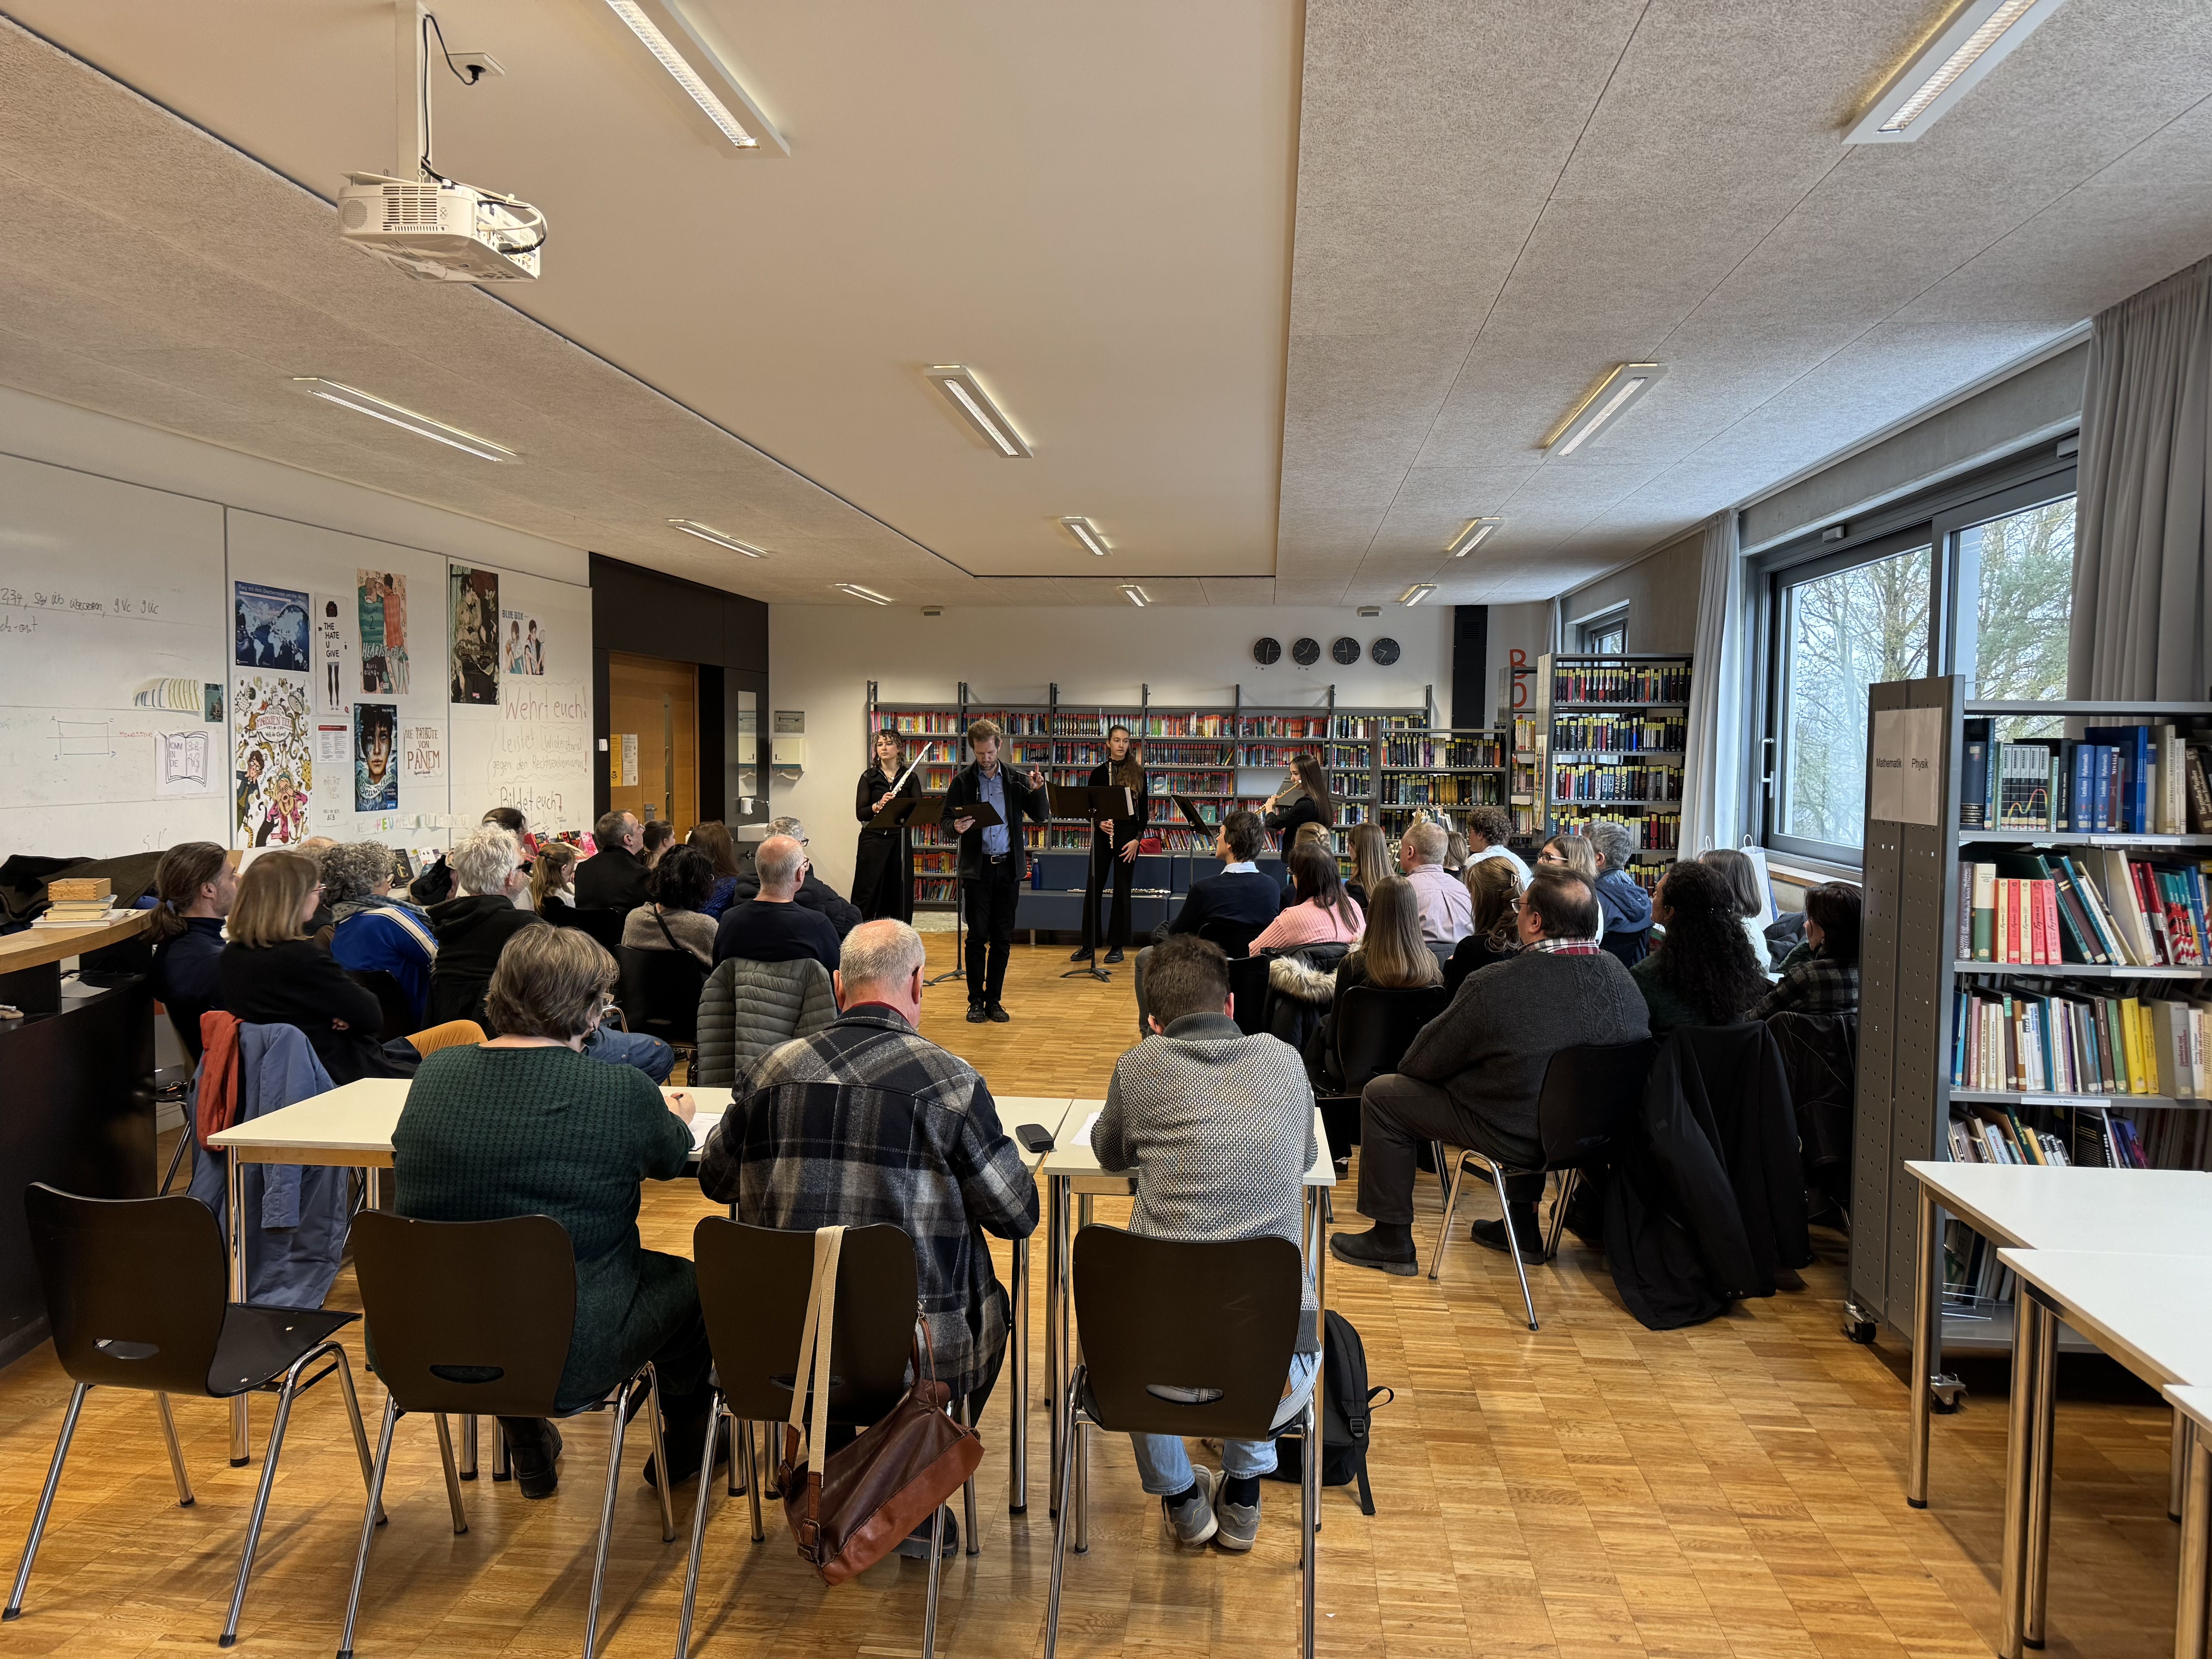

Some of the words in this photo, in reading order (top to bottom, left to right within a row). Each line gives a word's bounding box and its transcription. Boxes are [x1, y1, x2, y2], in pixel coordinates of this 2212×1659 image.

[369, 616, 376, 630] 2
[502, 610, 514, 619] BLUE
[515, 611, 524, 620] BOX
[505, 687, 548, 720] Wehrt
[554, 685, 587, 720] euch!
[416, 730, 438, 739] TRIBUTE
[407, 748, 440, 770] PANEM
[493, 761, 512, 777] gegen
[517, 758, 527, 770] den
[1876, 758, 1902, 768] Mathematik
[1911, 758, 1928, 771] Physik
[2191, 770, 2200, 790] Physiker
[536, 791, 556, 810] euch
[2033, 906, 2043, 930] Feynman
[2048, 907, 2056, 931] Feynman
[2057, 892, 2079, 932] mechanische
[2074, 932, 2084, 945] Das
